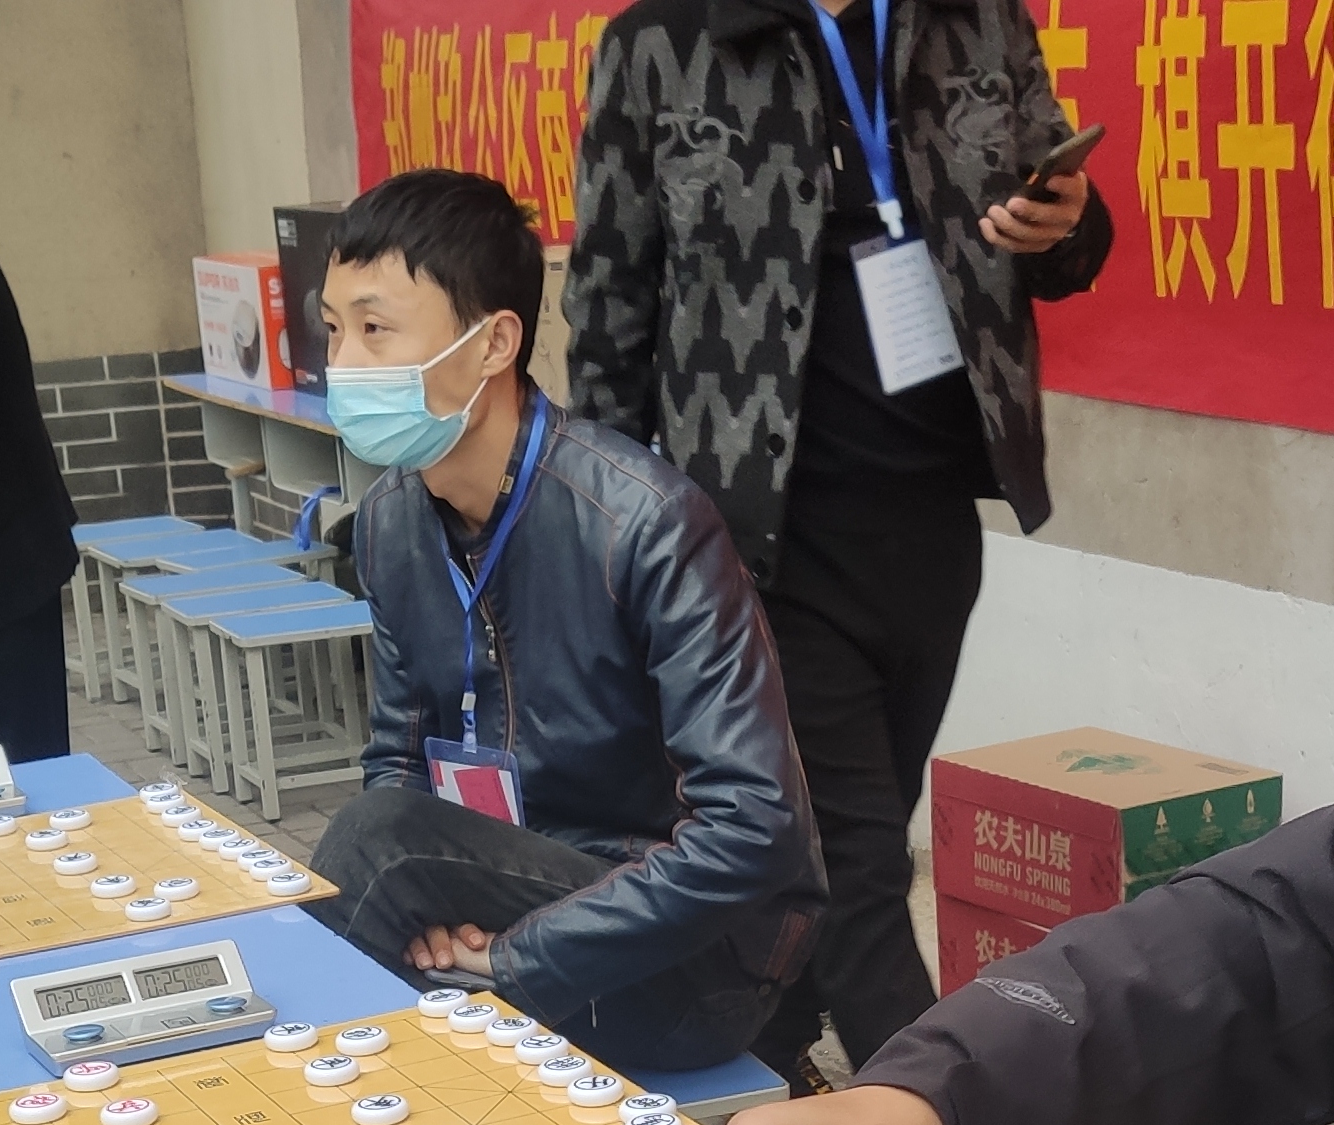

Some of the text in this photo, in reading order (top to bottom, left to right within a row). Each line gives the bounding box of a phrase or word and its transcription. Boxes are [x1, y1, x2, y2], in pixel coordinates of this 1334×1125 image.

[974, 810, 1072, 872] 农夫山泉
[974, 851, 1021, 881] NONGFU
[1026, 867, 1071, 896] SPRING
